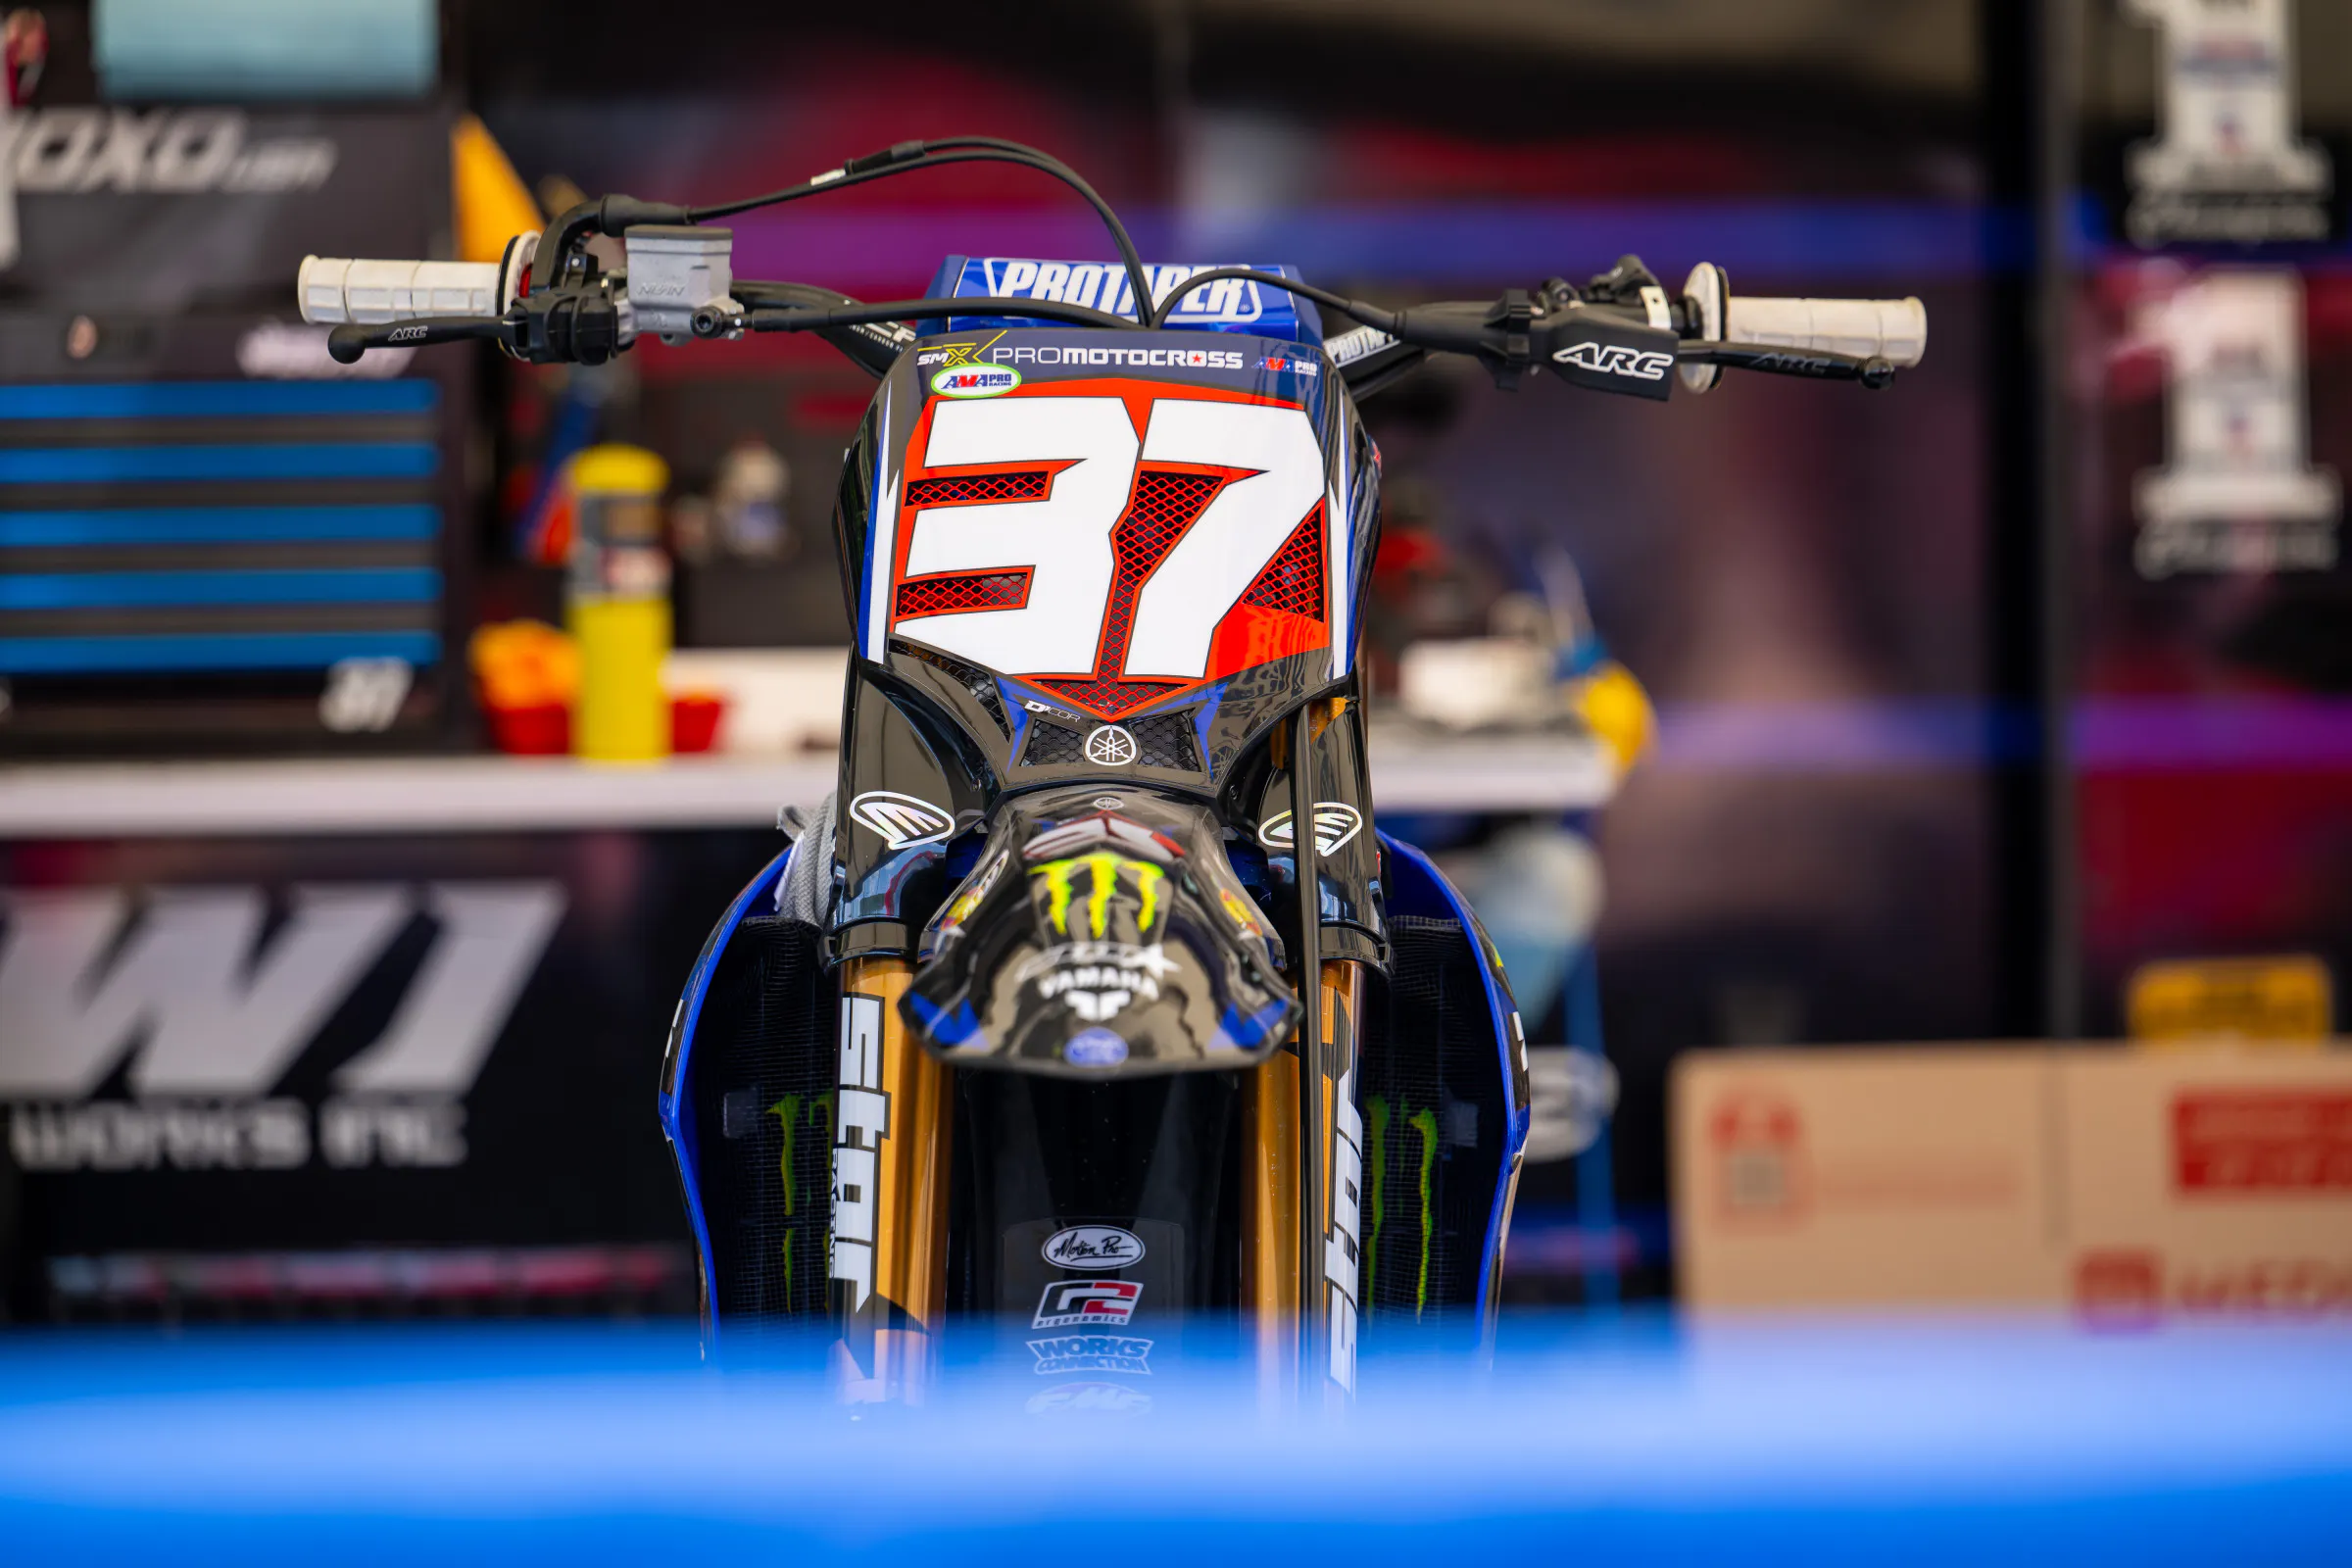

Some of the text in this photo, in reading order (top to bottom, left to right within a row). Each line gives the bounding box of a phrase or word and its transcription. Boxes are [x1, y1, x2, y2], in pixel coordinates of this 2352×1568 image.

[388, 325, 428, 342] ARC
[916, 347, 972, 368] SMX
[1251, 357, 1317, 372] AMA PRO
[1552, 341, 1674, 381] ARC
[941, 373, 1012, 389] AMA PRO
[894, 396, 1325, 678] 37
[1039, 966, 1159, 1002] YAMAHA
[8, 1101, 468, 1166] WORKS INC
[1054, 1231, 1134, 1258] Motion Pro
[1036, 1337, 1149, 1358] WORKS
[1036, 1356, 1145, 1371] CONNECTION
